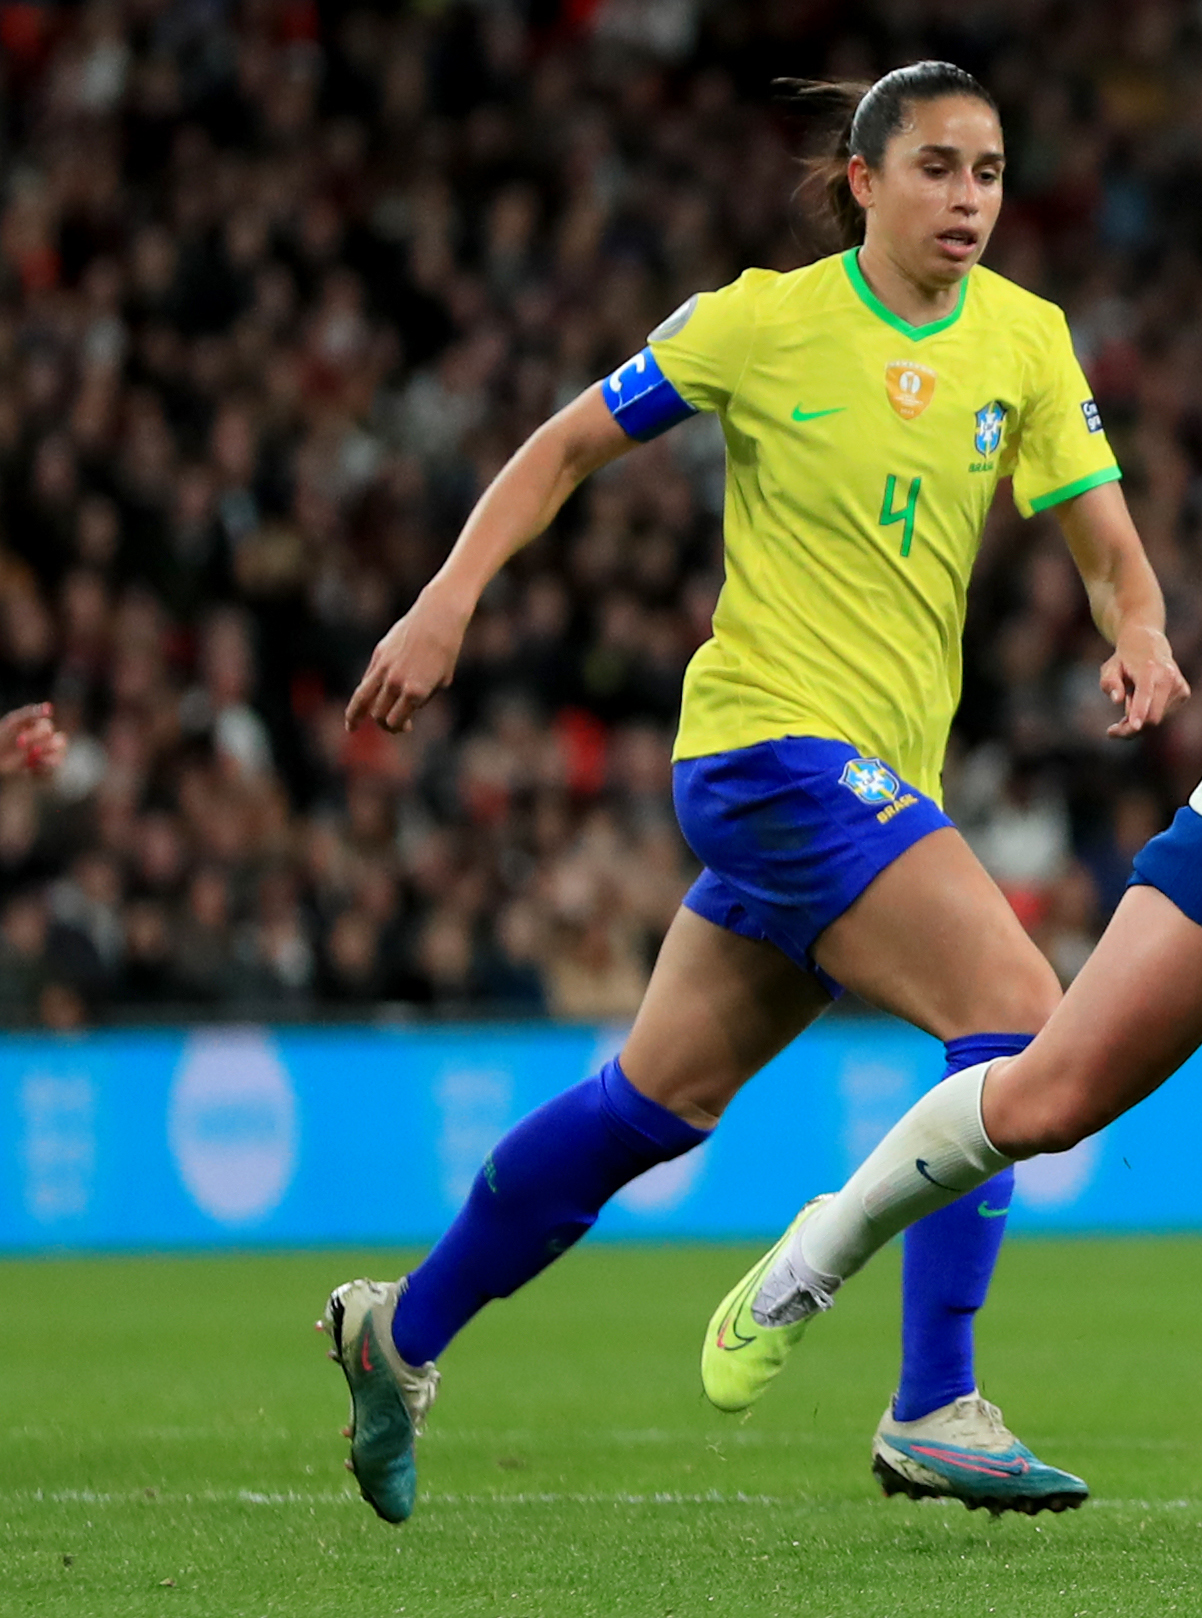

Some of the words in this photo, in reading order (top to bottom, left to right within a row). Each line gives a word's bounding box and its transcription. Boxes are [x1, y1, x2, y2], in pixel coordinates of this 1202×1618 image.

[609, 353, 646, 392] C
[880, 473, 921, 558] 4
[876, 793, 918, 824] BRASIL
